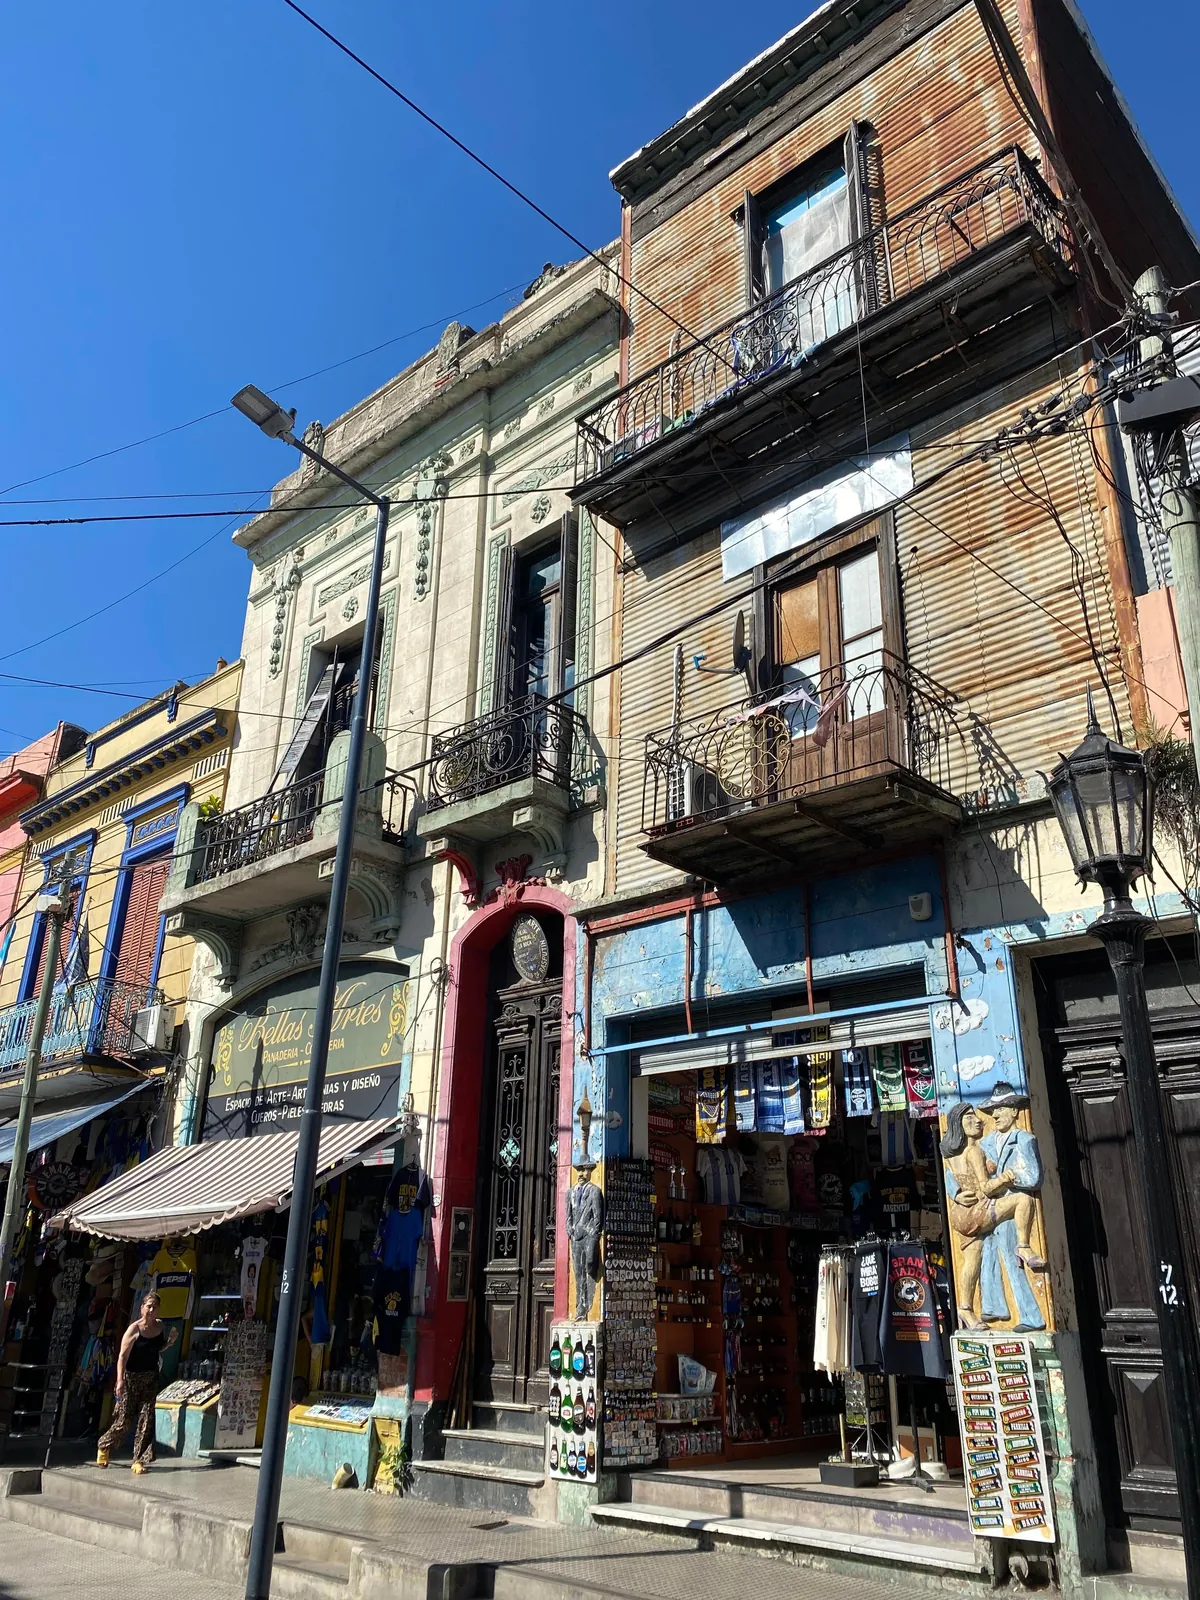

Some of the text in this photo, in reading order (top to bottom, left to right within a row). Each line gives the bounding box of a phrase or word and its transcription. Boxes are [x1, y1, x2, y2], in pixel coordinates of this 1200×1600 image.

[238, 981, 386, 1051] Bellas Artes
[262, 1048, 299, 1064] PANADERIA
[225, 1096, 252, 1112] ESPACIO
[255, 1095, 263, 1107] DE
[342, 1080, 349, 1092] Y
[351, 1073, 381, 1091] DISEÑO
[891, 1256, 925, 1269] GRAN
[160, 1275, 188, 1284] PEPSI
[282, 1269, 288, 1281] 6
[1160, 1261, 1173, 1285] 7
[1159, 1284, 1179, 1305] 12
